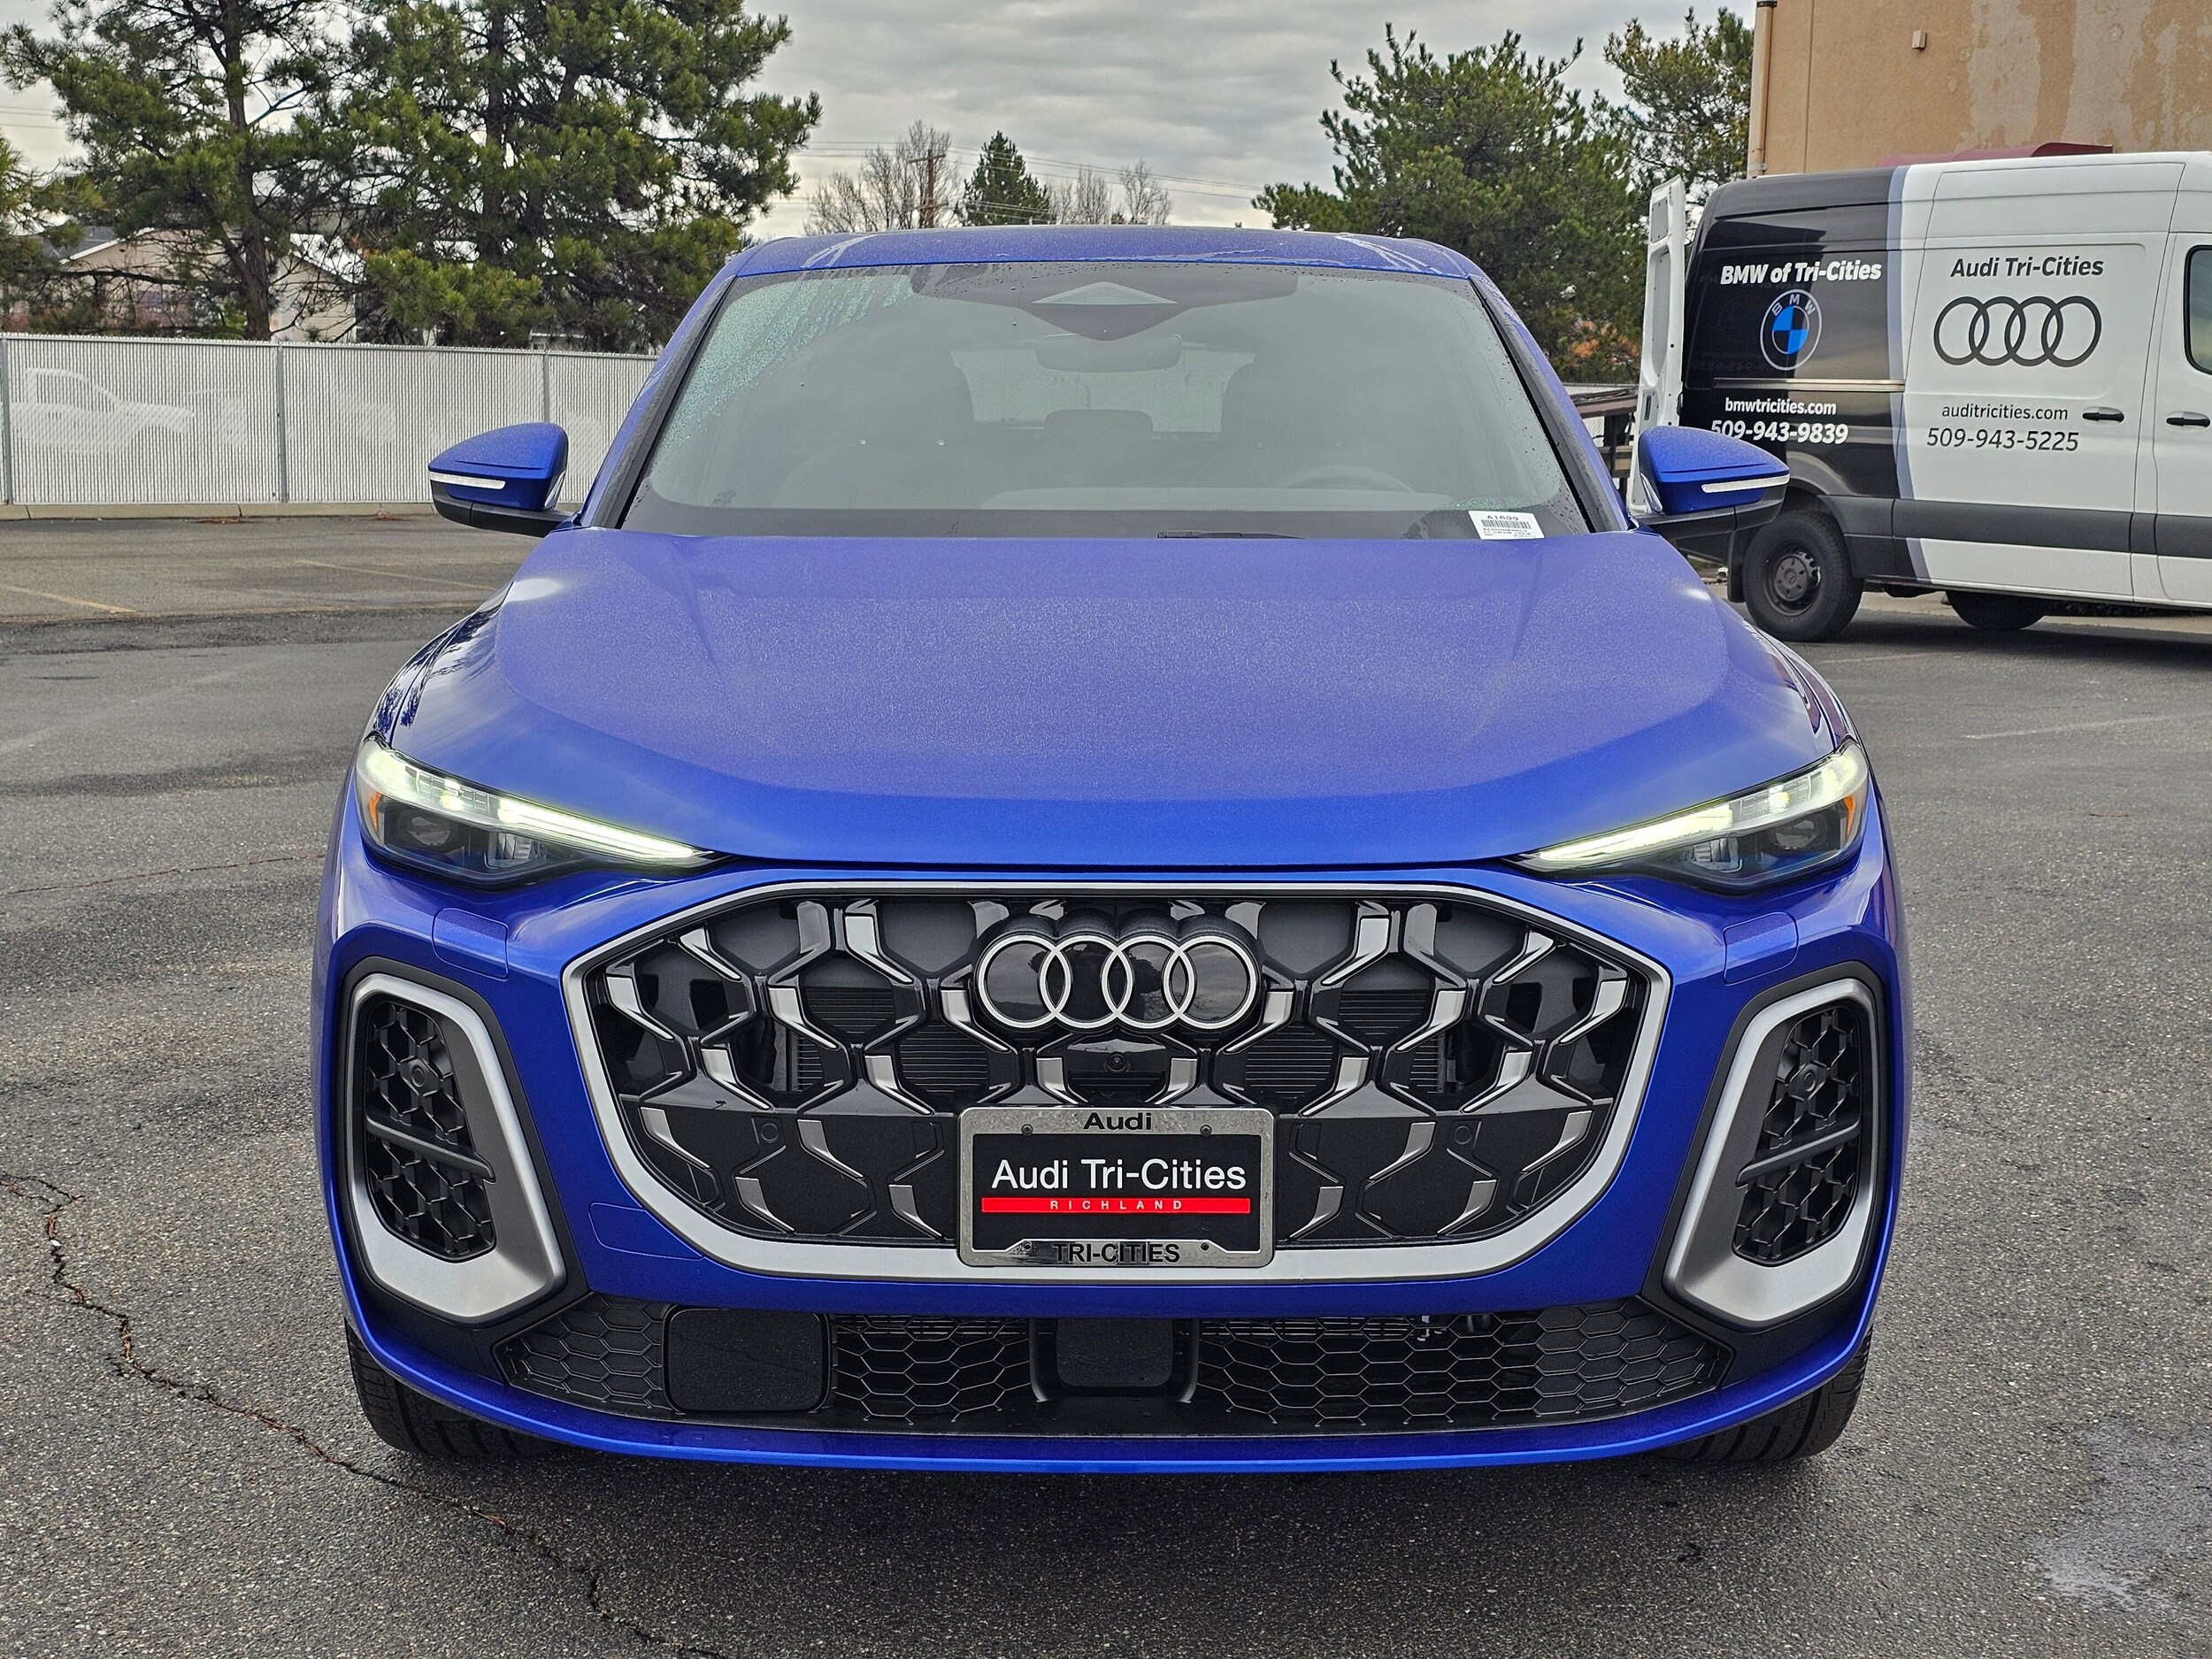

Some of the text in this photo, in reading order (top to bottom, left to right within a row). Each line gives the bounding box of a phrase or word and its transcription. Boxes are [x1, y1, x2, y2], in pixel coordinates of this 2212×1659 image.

[1720, 259, 1882, 285] BMW of Tri-Cities
[1950, 256, 2104, 278] Audi Tri-Cities
[1771, 293, 1816, 316] BMW
[1724, 397, 1837, 415] bmwtricities.com
[1941, 403, 2069, 420] auditricities.com
[1711, 419, 1849, 445] 509-943-9839
[1926, 427, 2079, 451] 509-943-5225
[1083, 1112, 1152, 1131] Audi
[991, 1158, 1247, 1189] Audi Tri-Cities
[1050, 1200, 1183, 1210] RICHLAND
[1052, 1243, 1180, 1263] TRI-CITIES
